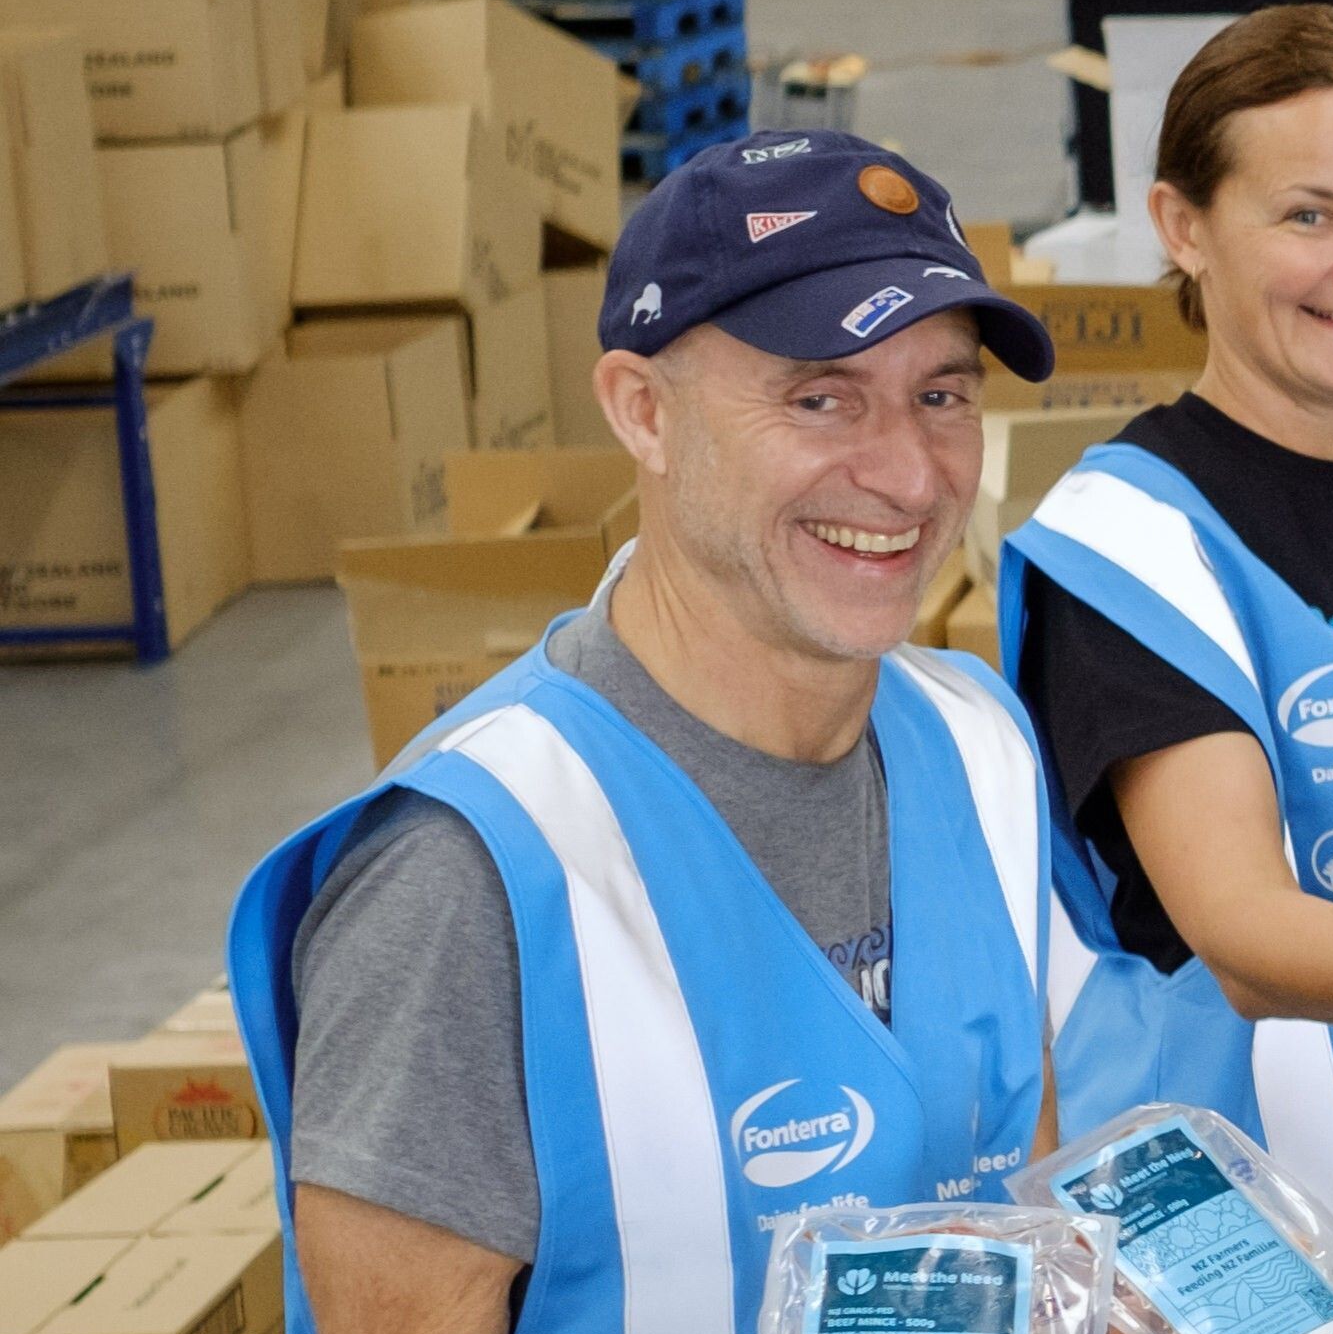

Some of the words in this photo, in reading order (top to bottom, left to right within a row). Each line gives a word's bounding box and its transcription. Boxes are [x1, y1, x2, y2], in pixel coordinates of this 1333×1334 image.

[743, 1111, 850, 1152] Fonterra
[1177, 1269, 1224, 1297] Feeding
[1222, 1257, 1238, 1273] NZ
[1237, 1239, 1281, 1263] Families
[1191, 1258, 1208, 1273] NZ
[1209, 1238, 1250, 1264] Farmers
[930, 1272, 958, 1284] the
[961, 1272, 1003, 1285] Need
[827, 1318, 855, 1327] BEEF
[858, 1318, 896, 1327] MINCE
[906, 1318, 936, 1328] 500g
